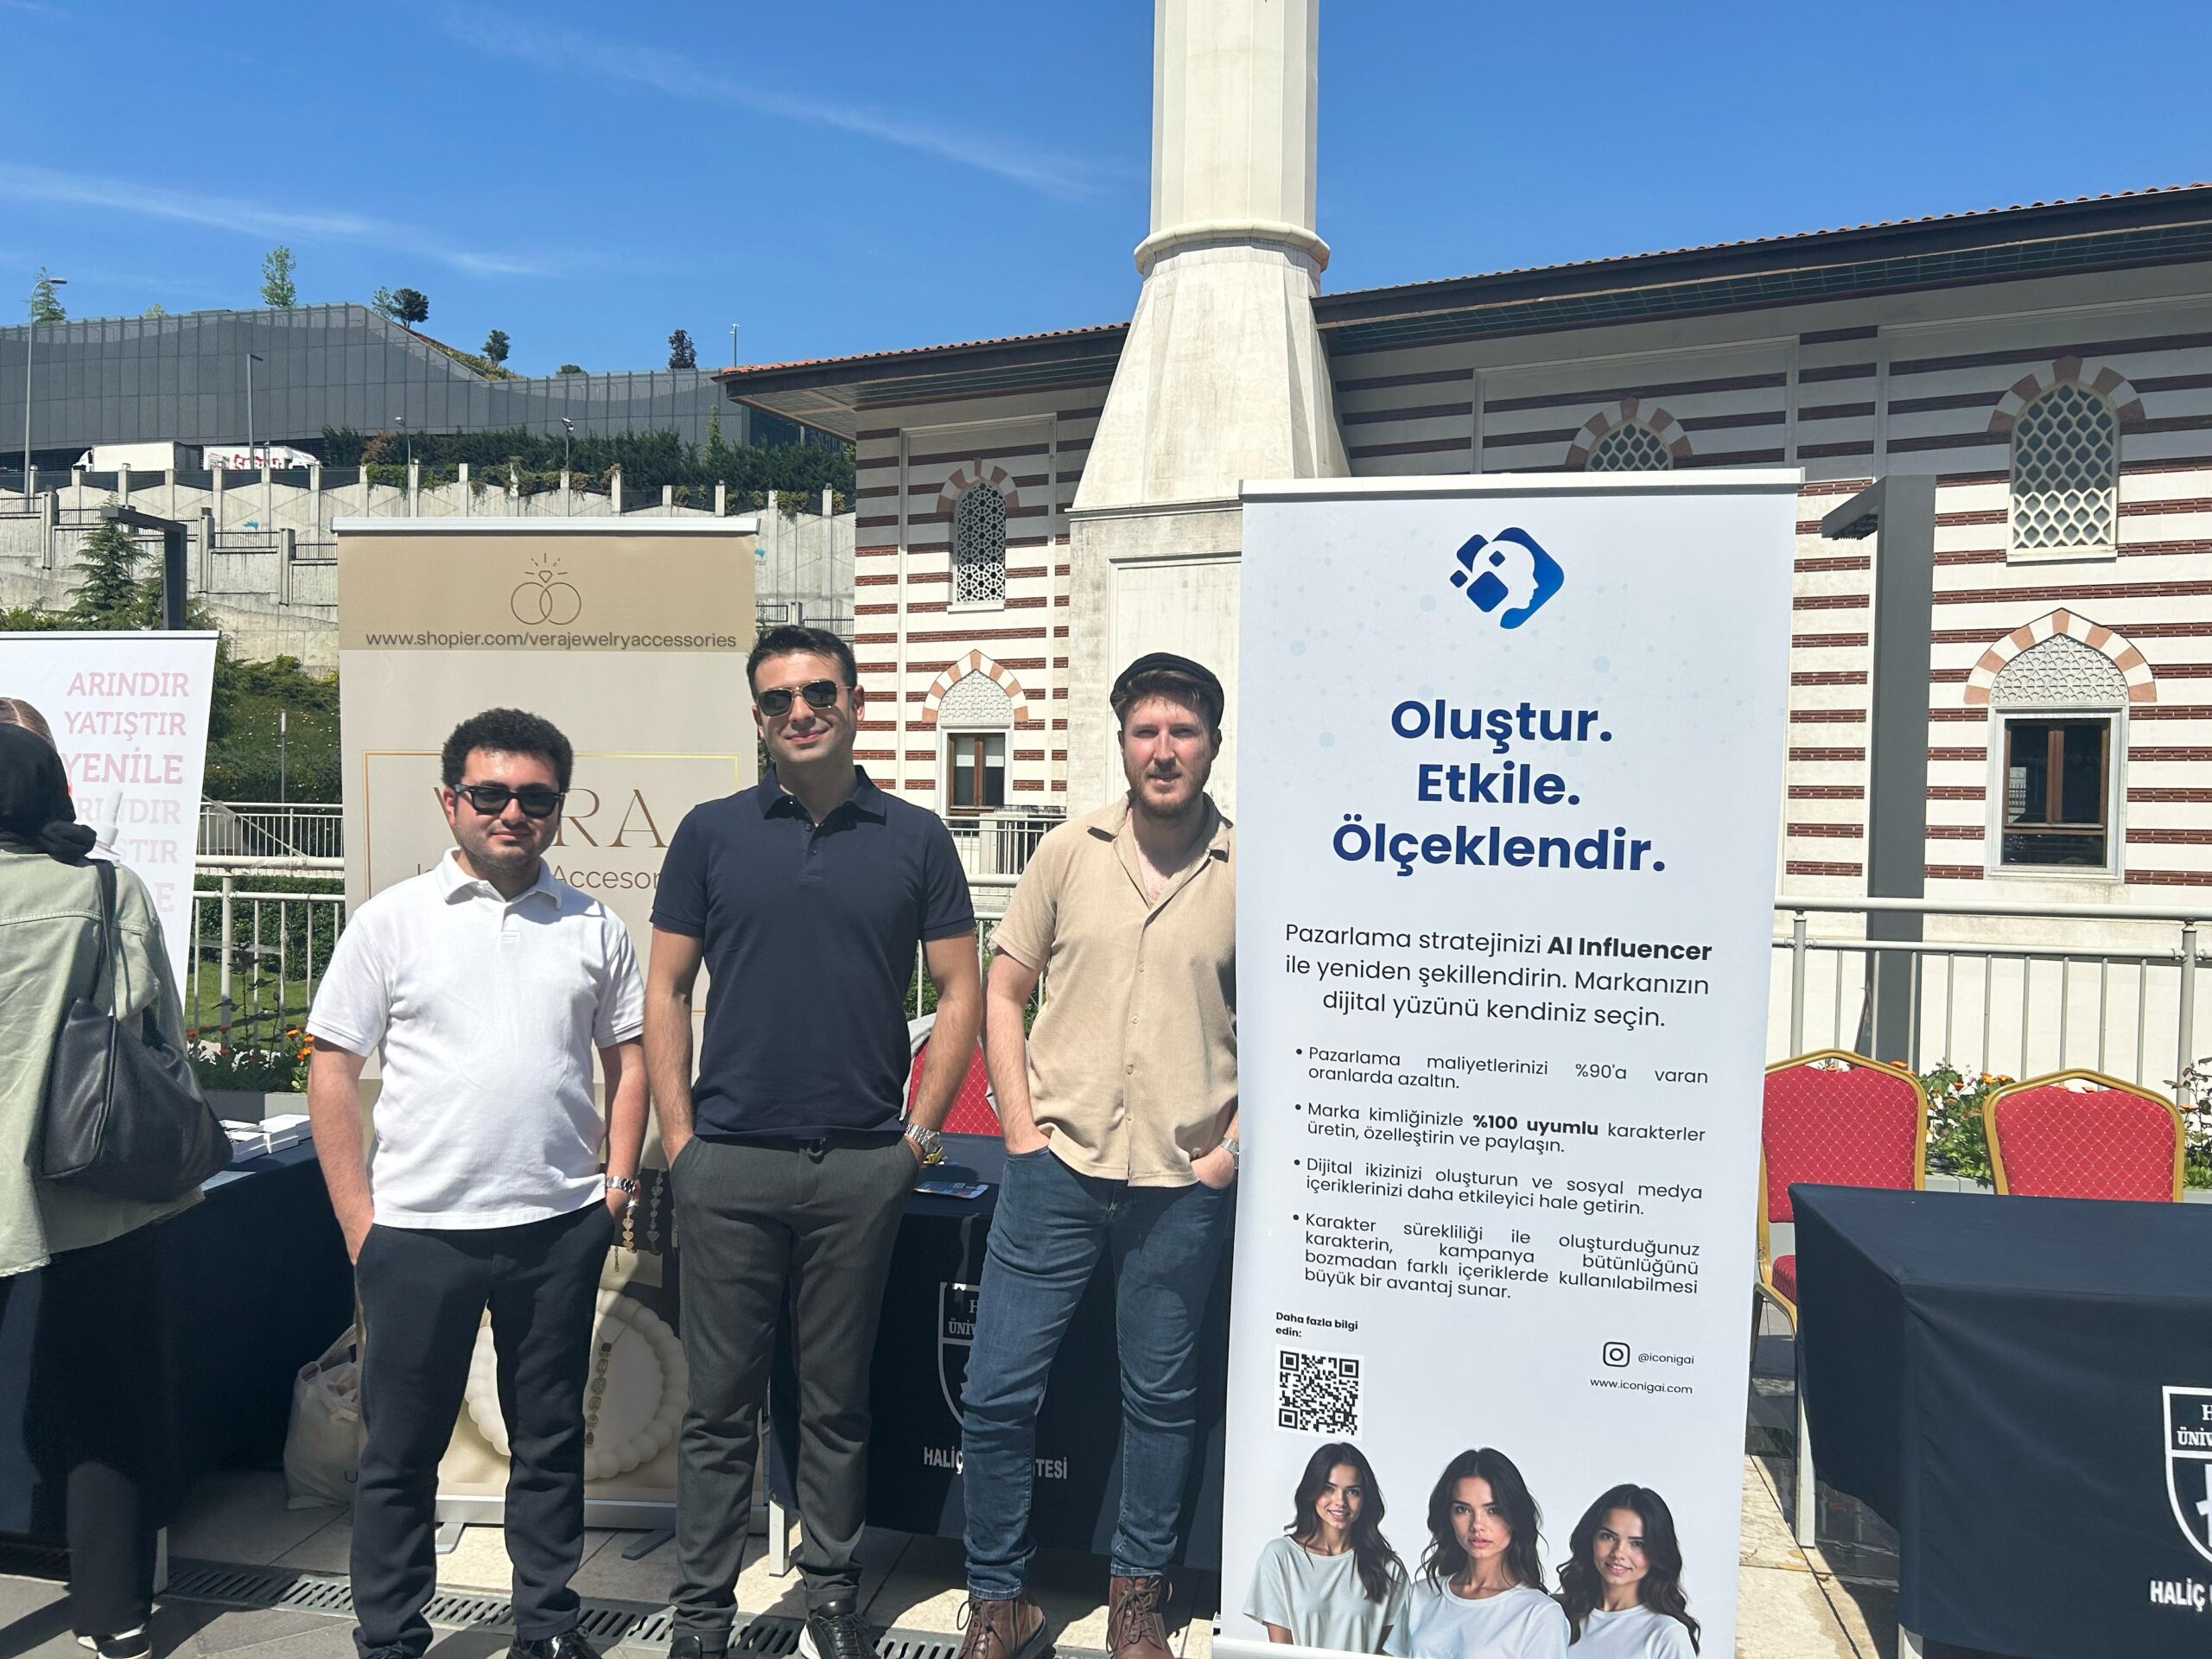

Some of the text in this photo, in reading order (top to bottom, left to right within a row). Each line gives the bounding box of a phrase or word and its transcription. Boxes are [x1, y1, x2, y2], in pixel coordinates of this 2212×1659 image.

[365, 631, 736, 650] www.shopier.com/verajewelryaccessories
[67, 672, 189, 697] ARINDIR
[65, 711, 187, 741] YATIŞTIR
[1391, 699, 1613, 753] Oluştur.
[61, 747, 183, 784] YENİLE
[1417, 760, 1581, 805] Etkile.
[76, 797, 181, 824] RIDIR
[1332, 814, 1667, 876] Ölçeklendir.
[553, 865, 661, 889] Accesor
[1287, 924, 1712, 960] Pazarlama stratejinizi AI Influencer
[1287, 955, 1708, 995] ile yeniden şekillendirin. Markanızın
[1323, 991, 1664, 1031] dijital yüzünü kendiniz seçin.
[1309, 1068, 1459, 1089] oranlarda azaltın.
[1310, 1047, 1707, 1084] Pazarlama maliyetlerinizi %90'a varan
[1308, 1103, 1706, 1141] Marka kimliğinizle %100 uyumlu karakterler
[1308, 1121, 1564, 1154] üretin, özelleştirin ve paylaşın.
[1307, 1158, 1701, 1202] Dijital ikizinizi oluşturun ve sosyal medya
[1307, 1175, 1643, 1215] içeriklerinizi daha etkileyici hale getirin.
[1306, 1213, 1700, 1257] Karakter sürekliliği ile oluşturduğunuz
[1306, 1230, 1698, 1277] karakterin, kampanya bütünlüğünü
[1306, 1249, 1697, 1294] bozmadan farklı içeriklerde kullanılabilmesi
[1306, 1267, 1510, 1298] büyük bir avantaj sunar.
[1275, 1312, 1358, 1332] Daha fazla bilgi
[1275, 1326, 1302, 1338] edin:
[1638, 1352, 1694, 1366] @iconigai
[1590, 1379, 1693, 1394] www.iconigai.com
[2150, 1578, 2206, 1611] HALİÇ
